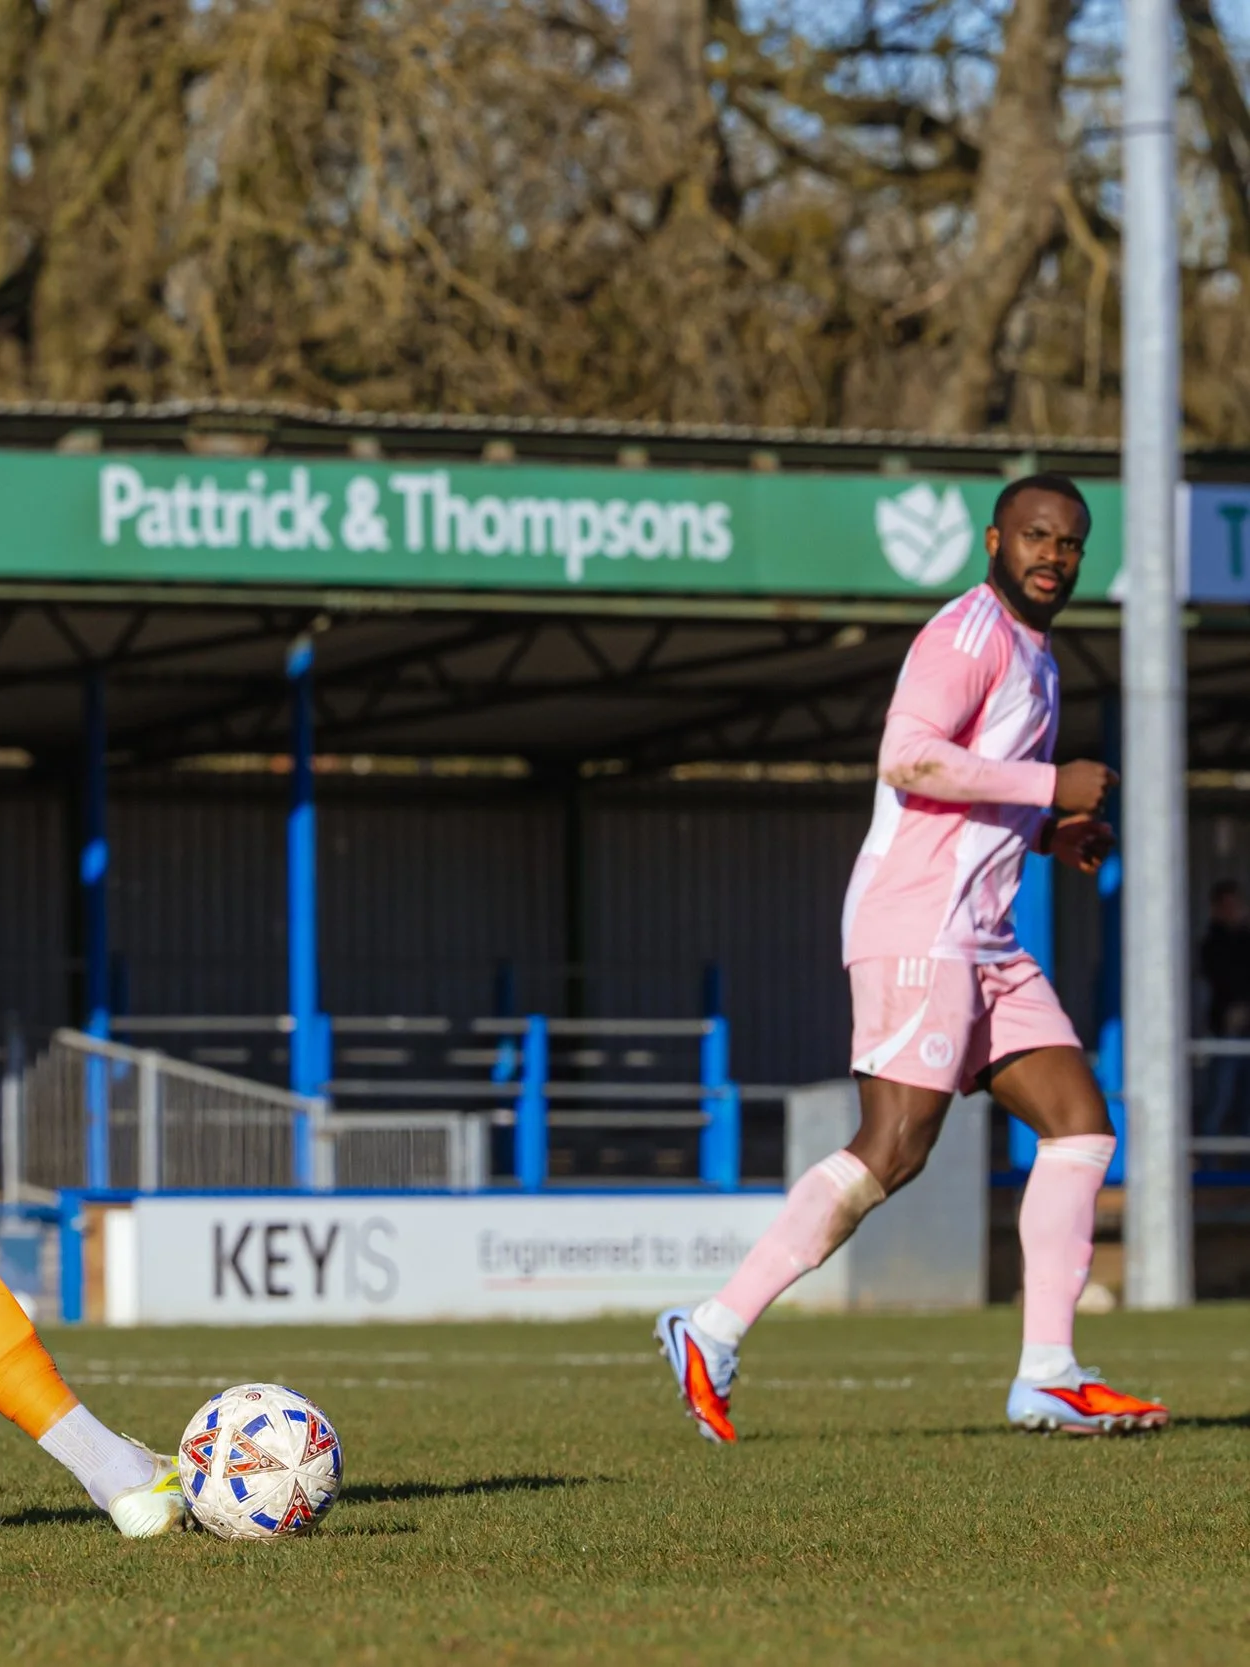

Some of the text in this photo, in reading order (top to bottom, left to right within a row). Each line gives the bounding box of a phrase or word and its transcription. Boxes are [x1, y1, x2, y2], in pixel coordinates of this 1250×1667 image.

[100, 464, 733, 583] Pattrick & Thompsons
[478, 1230, 644, 1280] Engineered
